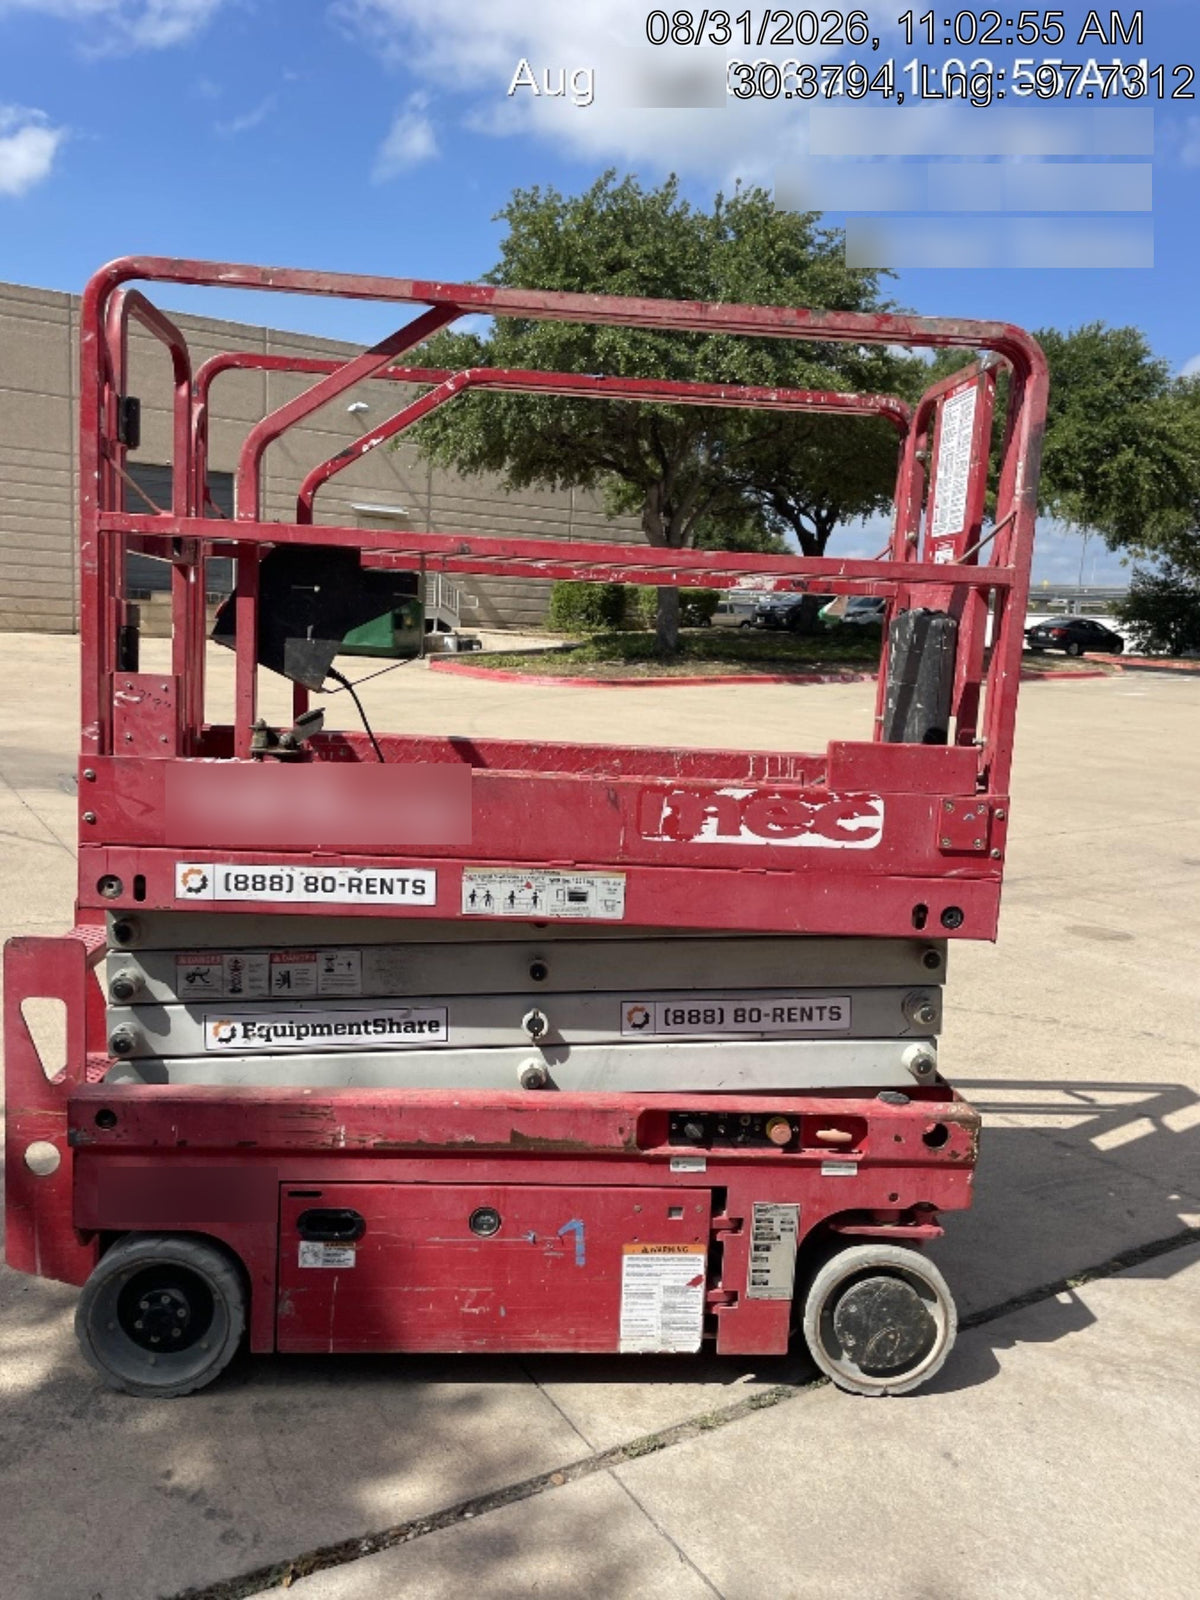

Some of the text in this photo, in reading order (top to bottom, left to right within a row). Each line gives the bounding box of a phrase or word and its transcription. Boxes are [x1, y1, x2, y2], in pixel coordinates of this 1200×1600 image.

[223, 872, 427, 896] (888) 80-RENTS
[663, 1004, 843, 1026] (888) 80-RENTS
[240, 1015, 441, 1041] EquipmentShare
